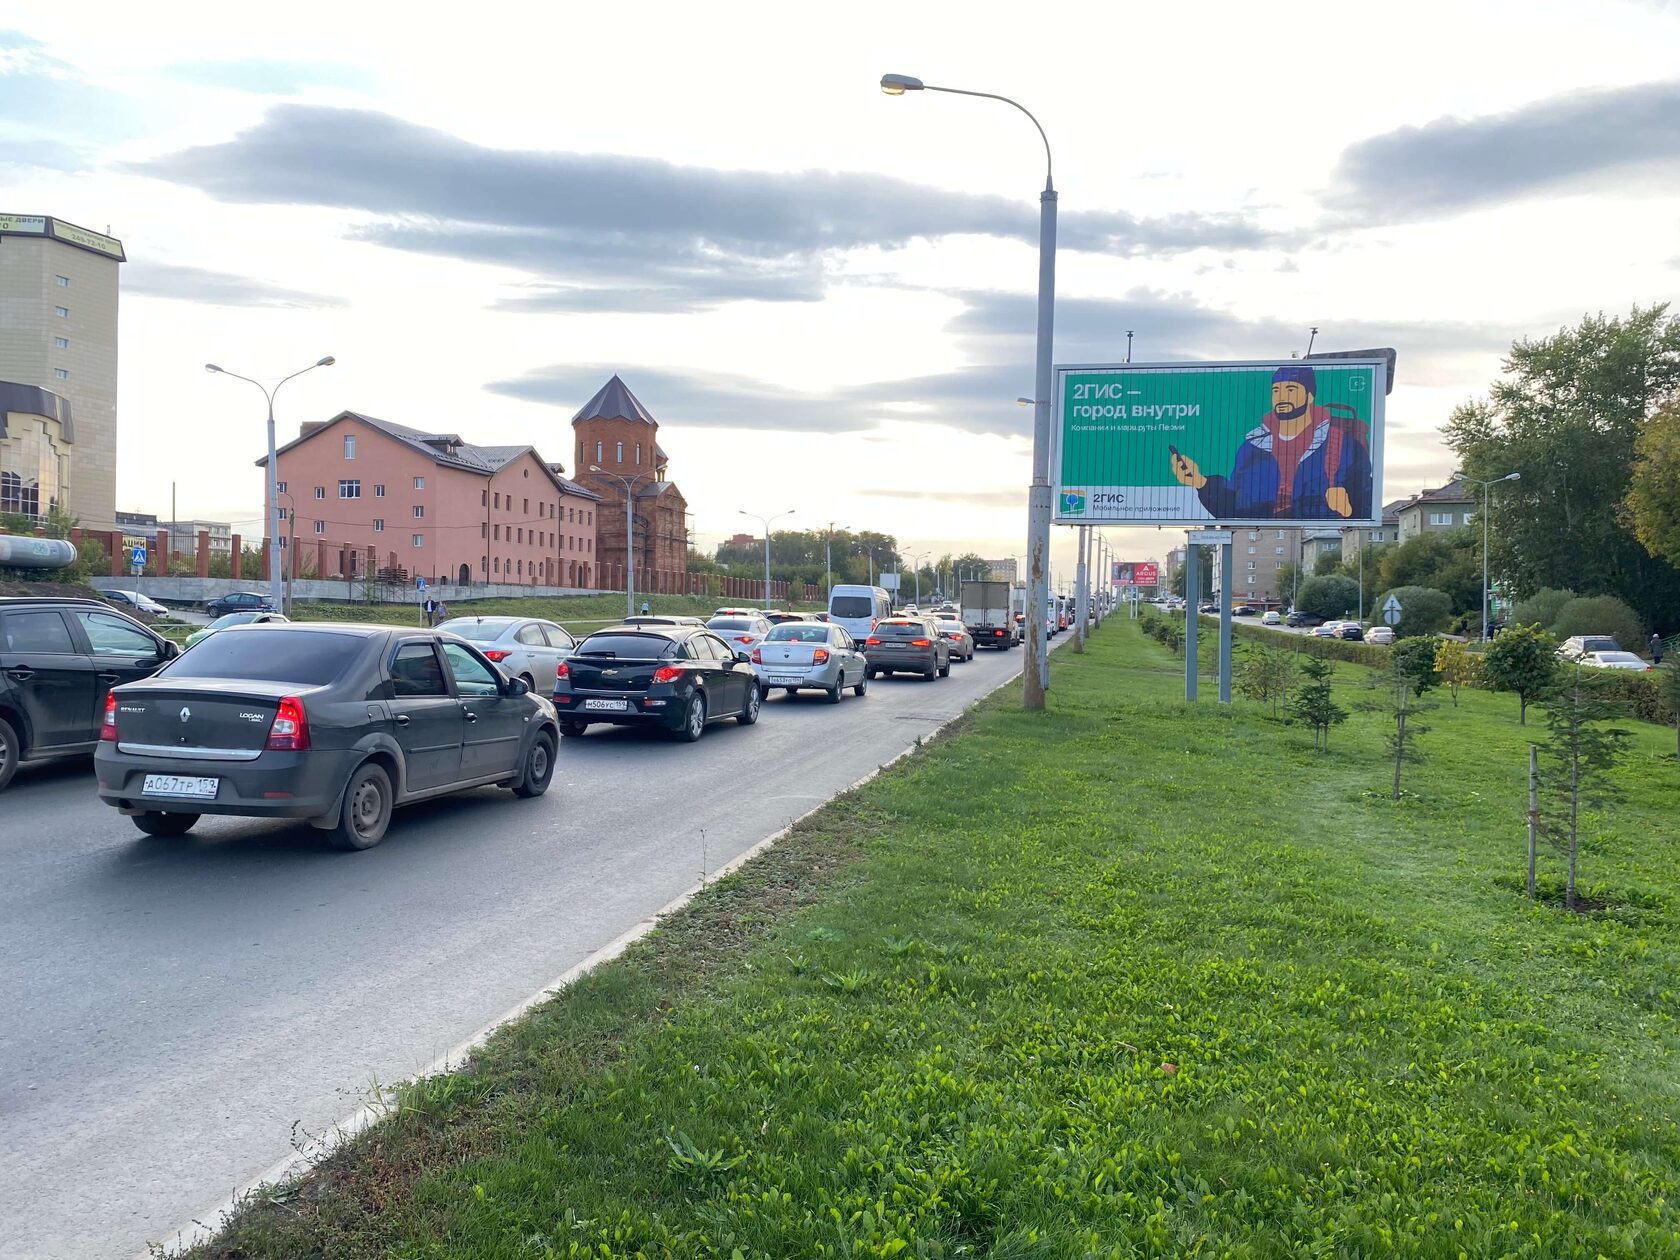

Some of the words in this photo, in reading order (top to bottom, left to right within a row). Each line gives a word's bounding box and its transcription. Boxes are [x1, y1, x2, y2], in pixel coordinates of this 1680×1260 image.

[1073, 383, 1123, 399] 2ГИС
[1073, 404, 1127, 420] город
[1132, 404, 1200, 420] внутри
[1159, 423, 1185, 431] Перми
[1093, 494, 1125, 503] 2ГИС
